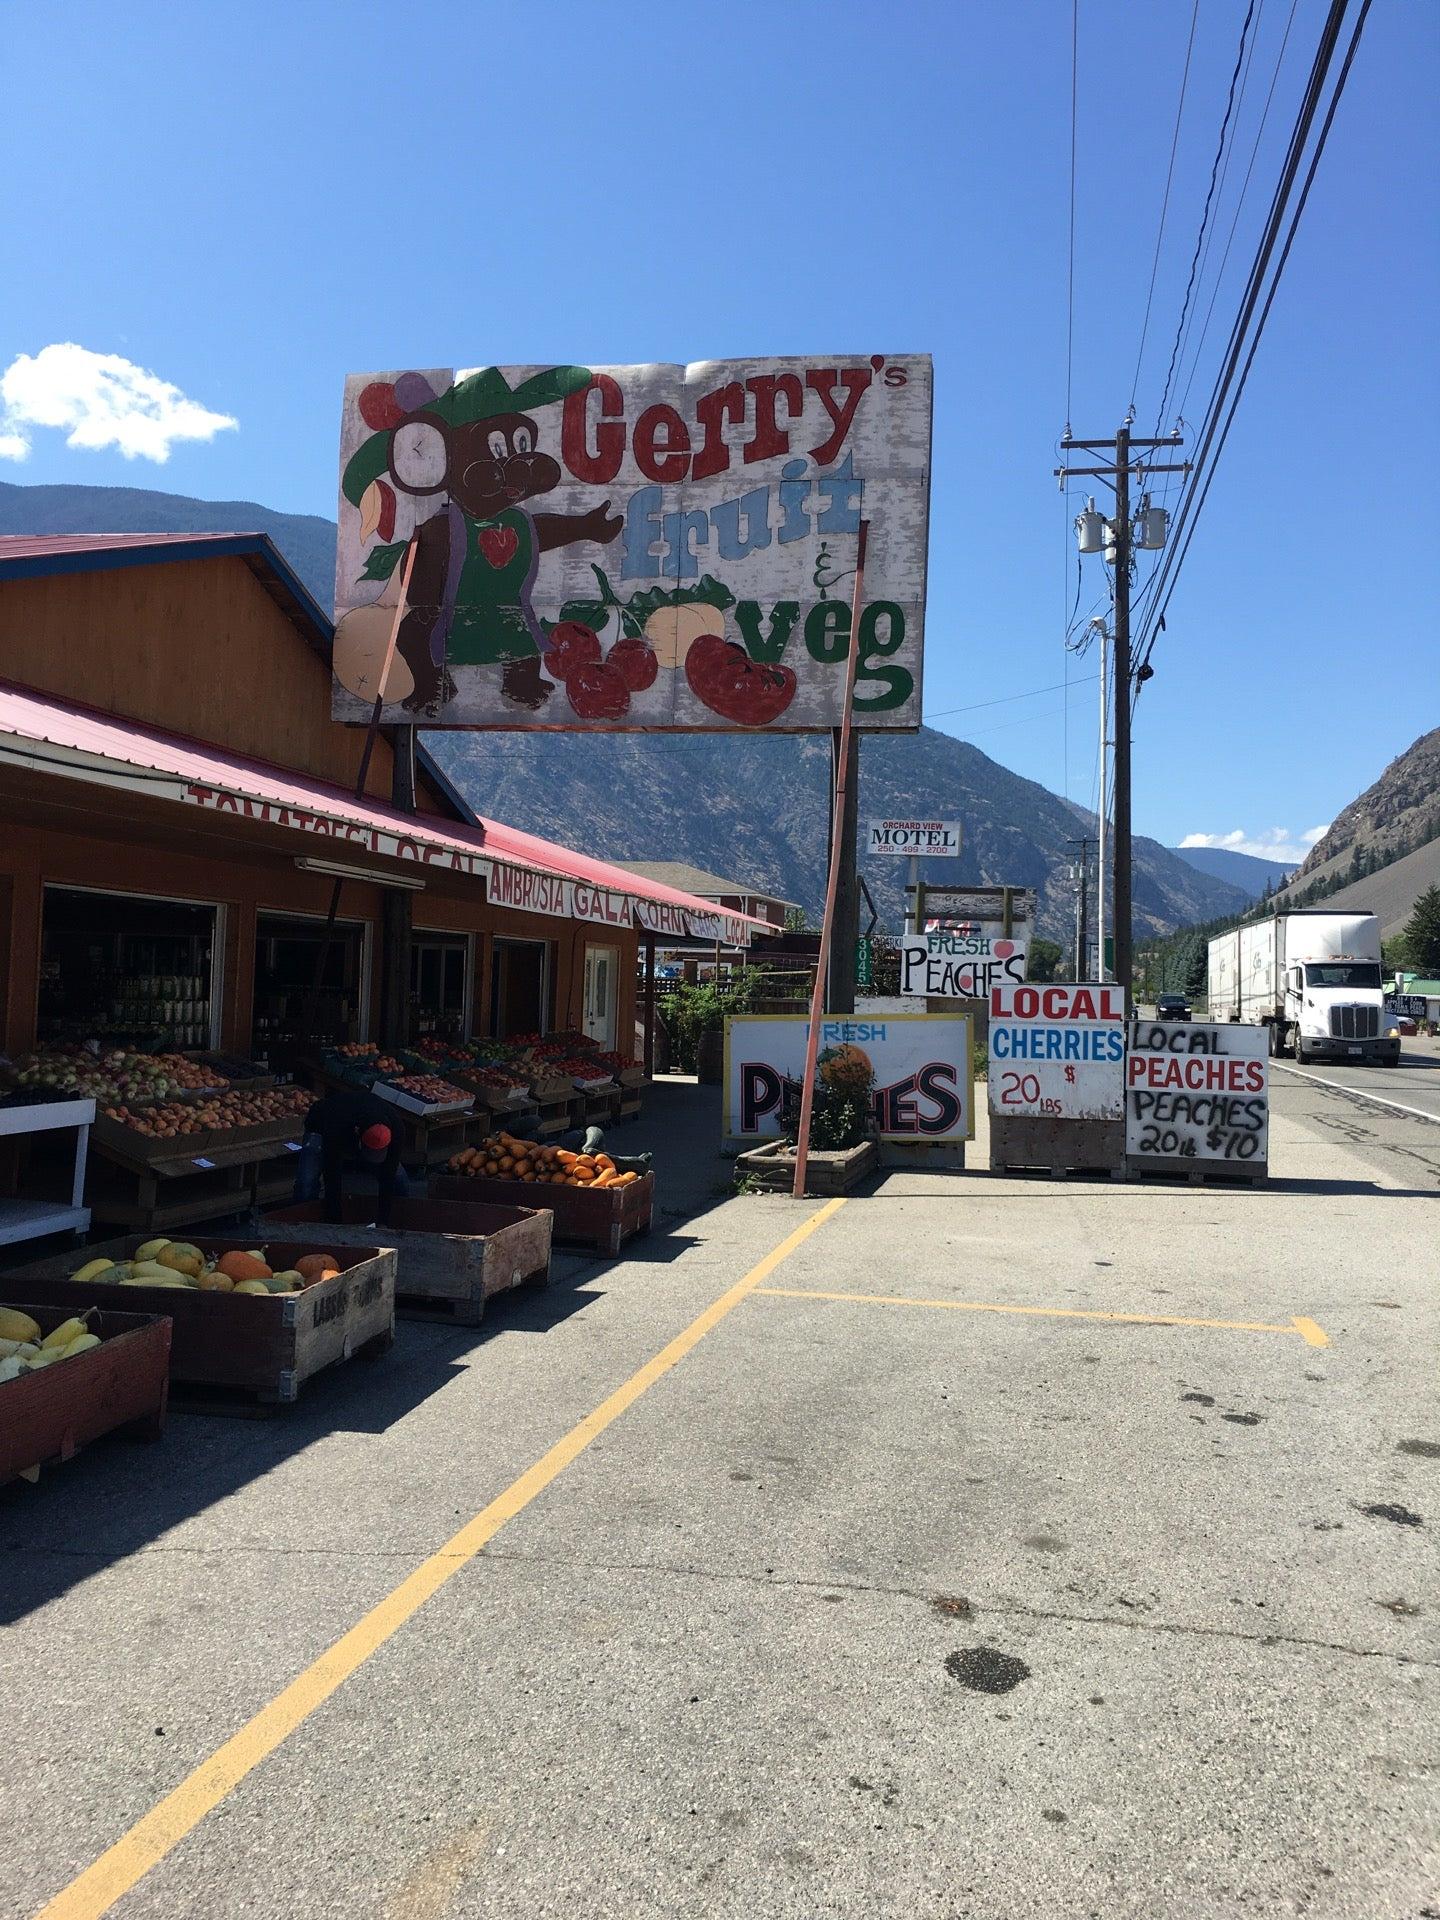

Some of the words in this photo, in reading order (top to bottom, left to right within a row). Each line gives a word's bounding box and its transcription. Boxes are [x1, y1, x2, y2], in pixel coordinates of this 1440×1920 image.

[562, 354, 908, 485] Gerry's
[620, 450, 864, 579] fruit
[733, 599, 914, 712] veg
[871, 828, 956, 847] MOTEL
[882, 821, 920, 830] ORCHARD
[489, 863, 564, 914] AMBROSIA
[573, 883, 631, 926] GALA
[637, 898, 682, 934] CORN
[725, 916, 750, 946] LOCAL
[857, 938, 868, 982] 3045
[927, 936, 992, 956] FRESH
[903, 947, 1026, 999] PEACHES
[991, 987, 1122, 1021] LOCAL
[992, 1028, 1123, 1062] CHERRIES
[1132, 1022, 1229, 1055] LOCAL
[1064, 1064, 1075, 1085] $
[1129, 1056, 1264, 1092] PEACHES
[1133, 1090, 1266, 1131] PEACHES
[1206, 1124, 1259, 1160] $10
